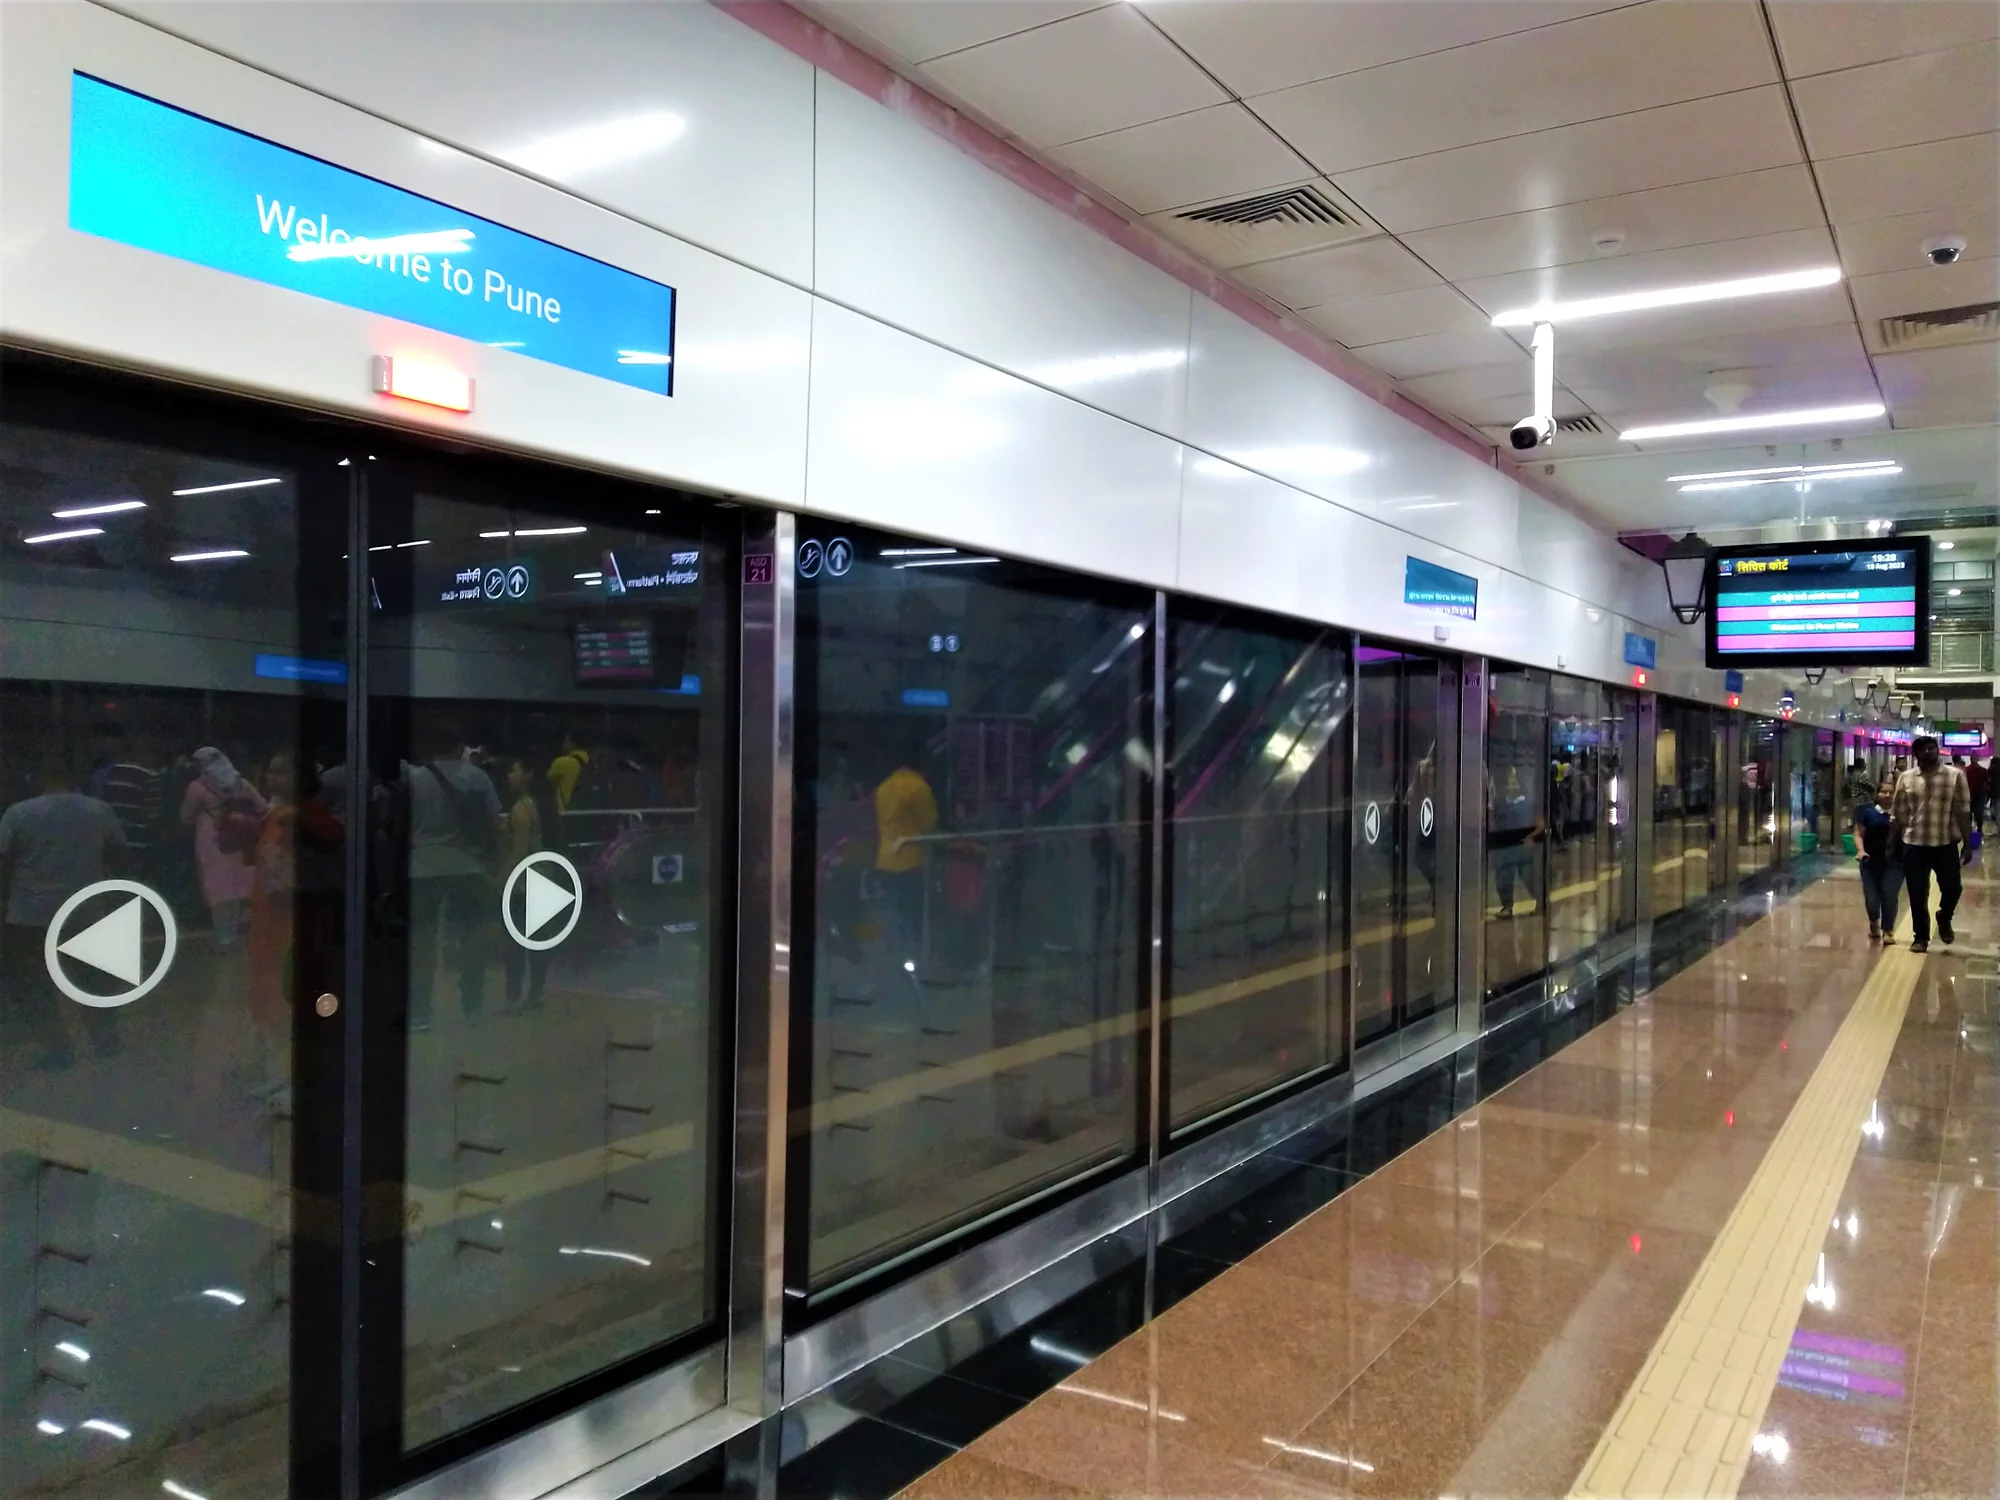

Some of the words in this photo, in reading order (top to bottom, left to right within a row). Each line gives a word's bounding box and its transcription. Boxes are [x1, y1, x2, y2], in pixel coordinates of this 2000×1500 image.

[440, 256, 474, 296] to
[484, 269, 561, 324] Pune
[751, 568, 766, 582] 21
